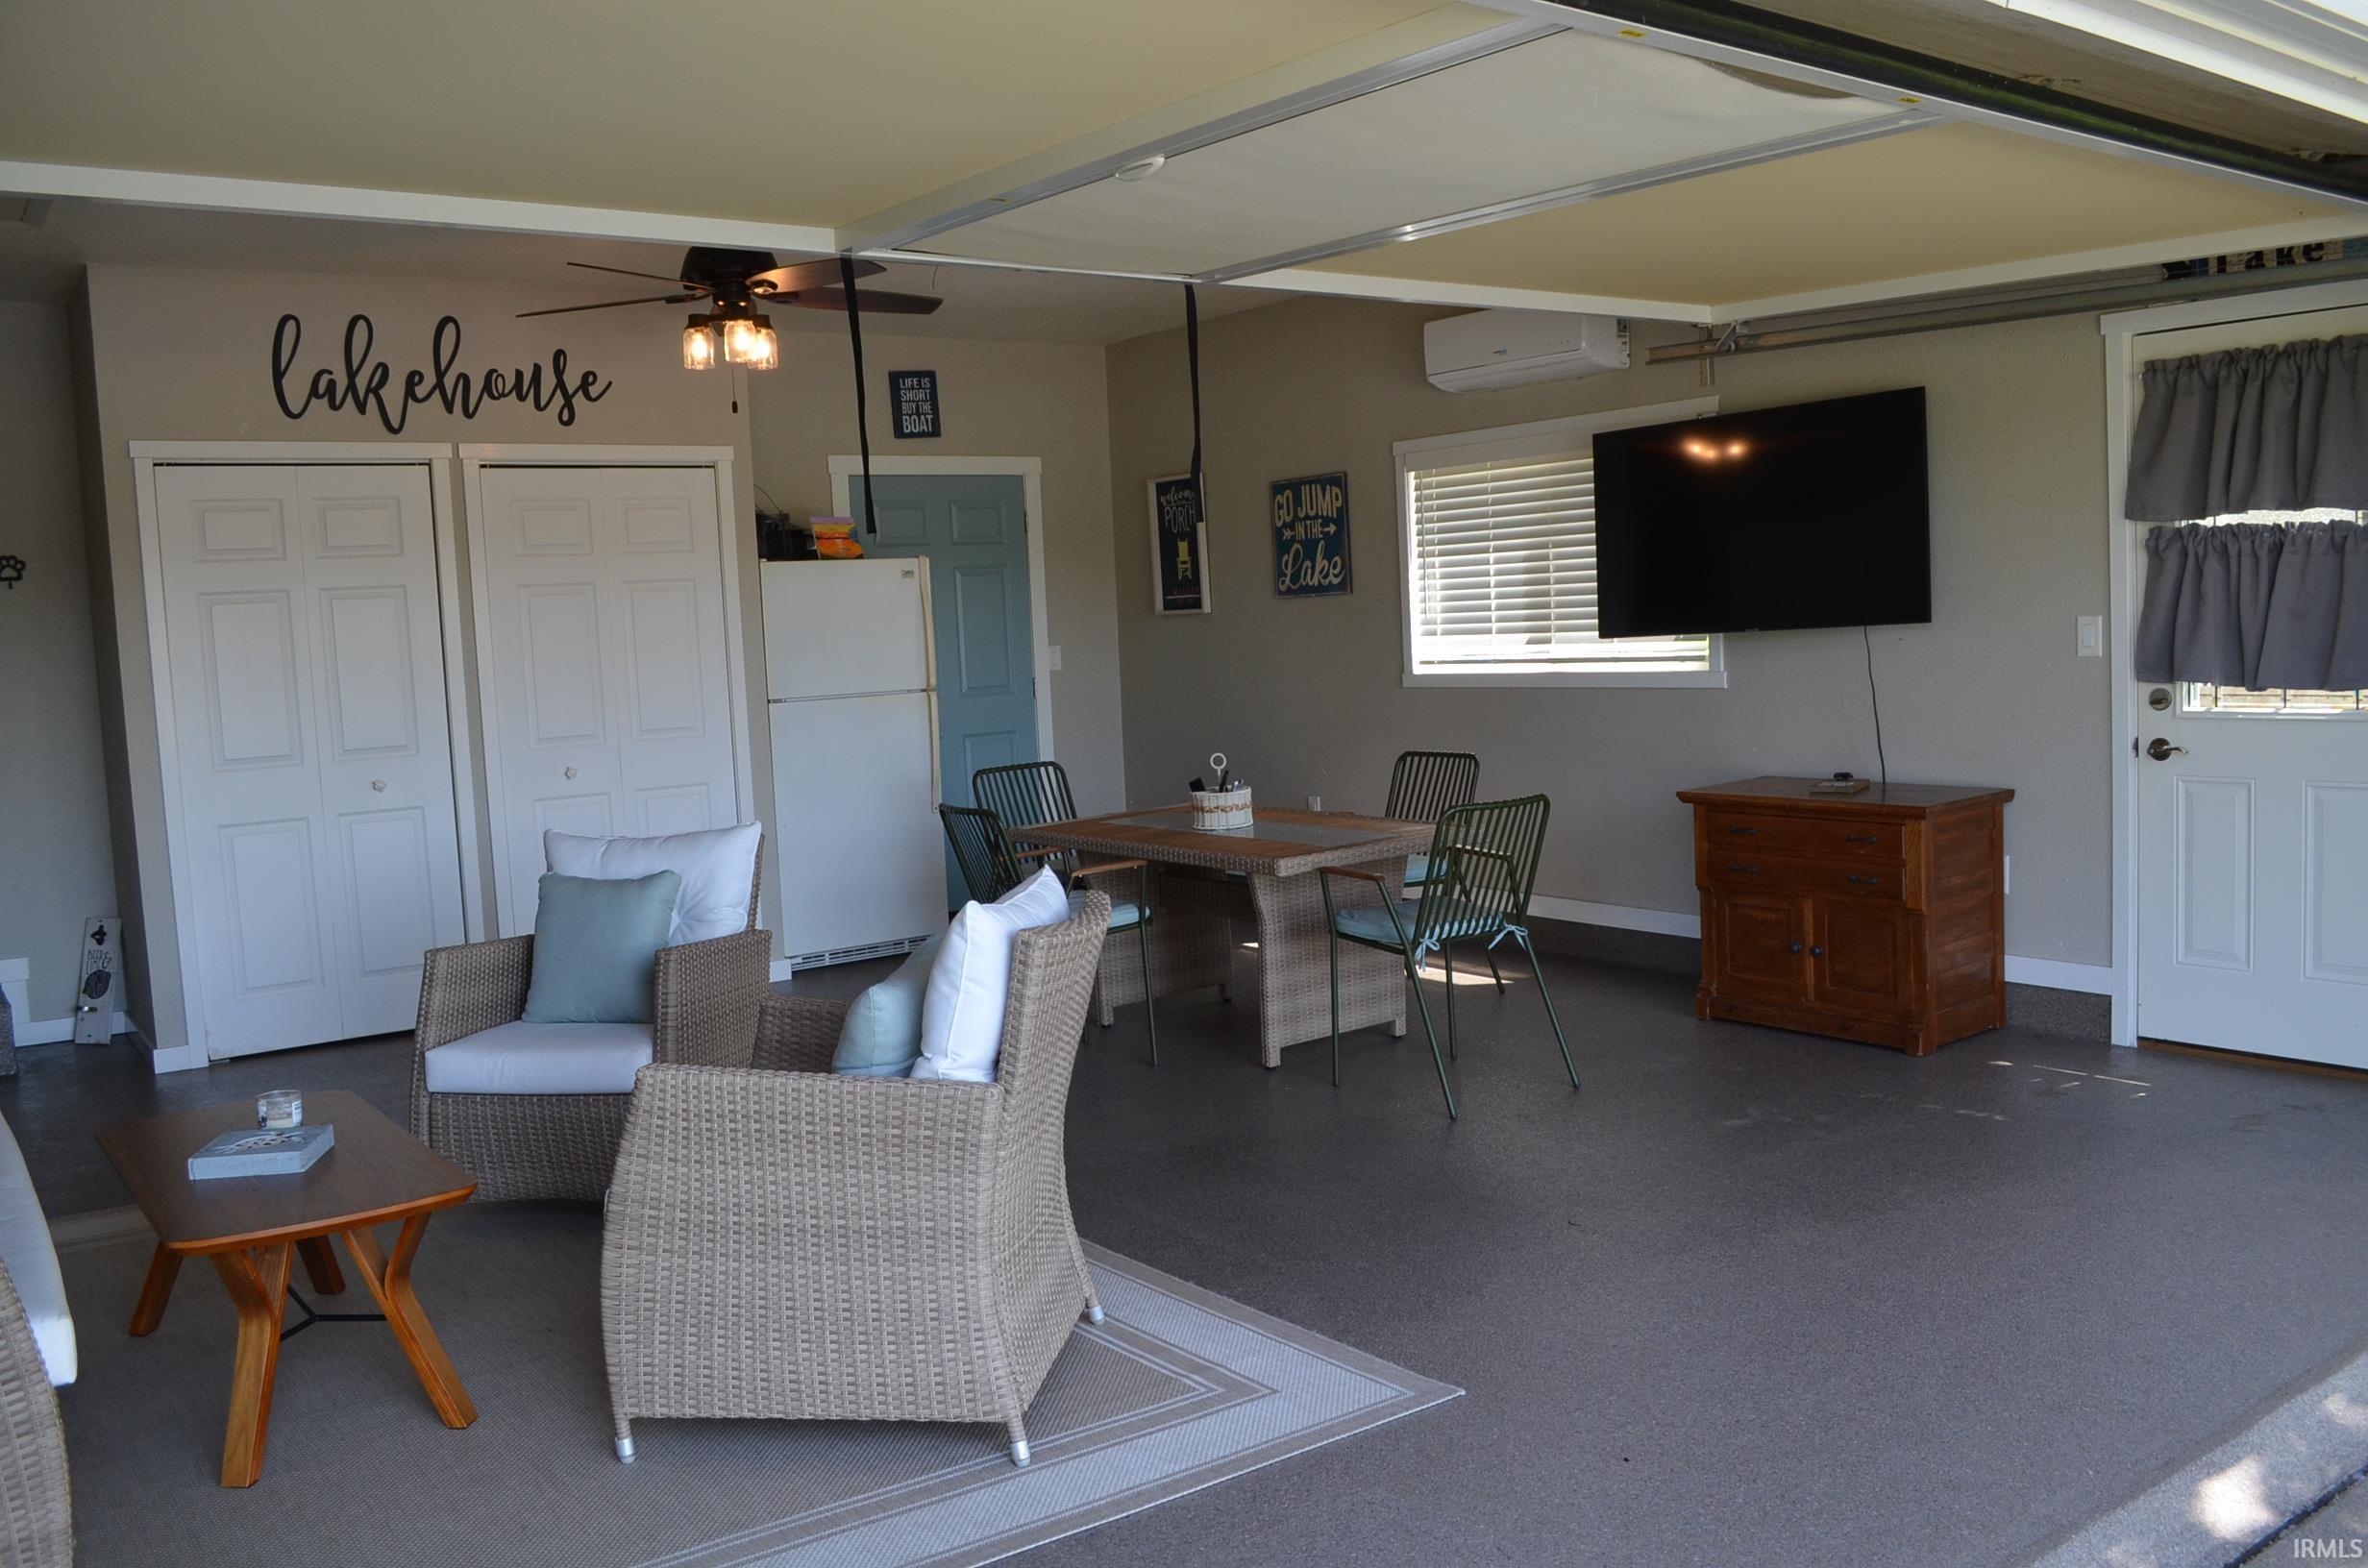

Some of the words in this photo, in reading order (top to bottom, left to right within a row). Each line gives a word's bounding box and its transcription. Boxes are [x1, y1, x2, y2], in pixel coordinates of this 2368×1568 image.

[272, 313, 613, 435] lakehouse
[900, 378, 920, 389] LIFE
[921, 378, 930, 388] IS
[900, 389, 930, 402] SHORT
[901, 402, 917, 414] BUY
[917, 402, 933, 414] THE
[902, 414, 933, 433] BOAT
[1274, 489, 1294, 527] GO
[1297, 483, 1343, 519] JUMP
[1295, 521, 1305, 540] IN
[1306, 519, 1323, 539] THE
[1278, 539, 1346, 592] Lake
